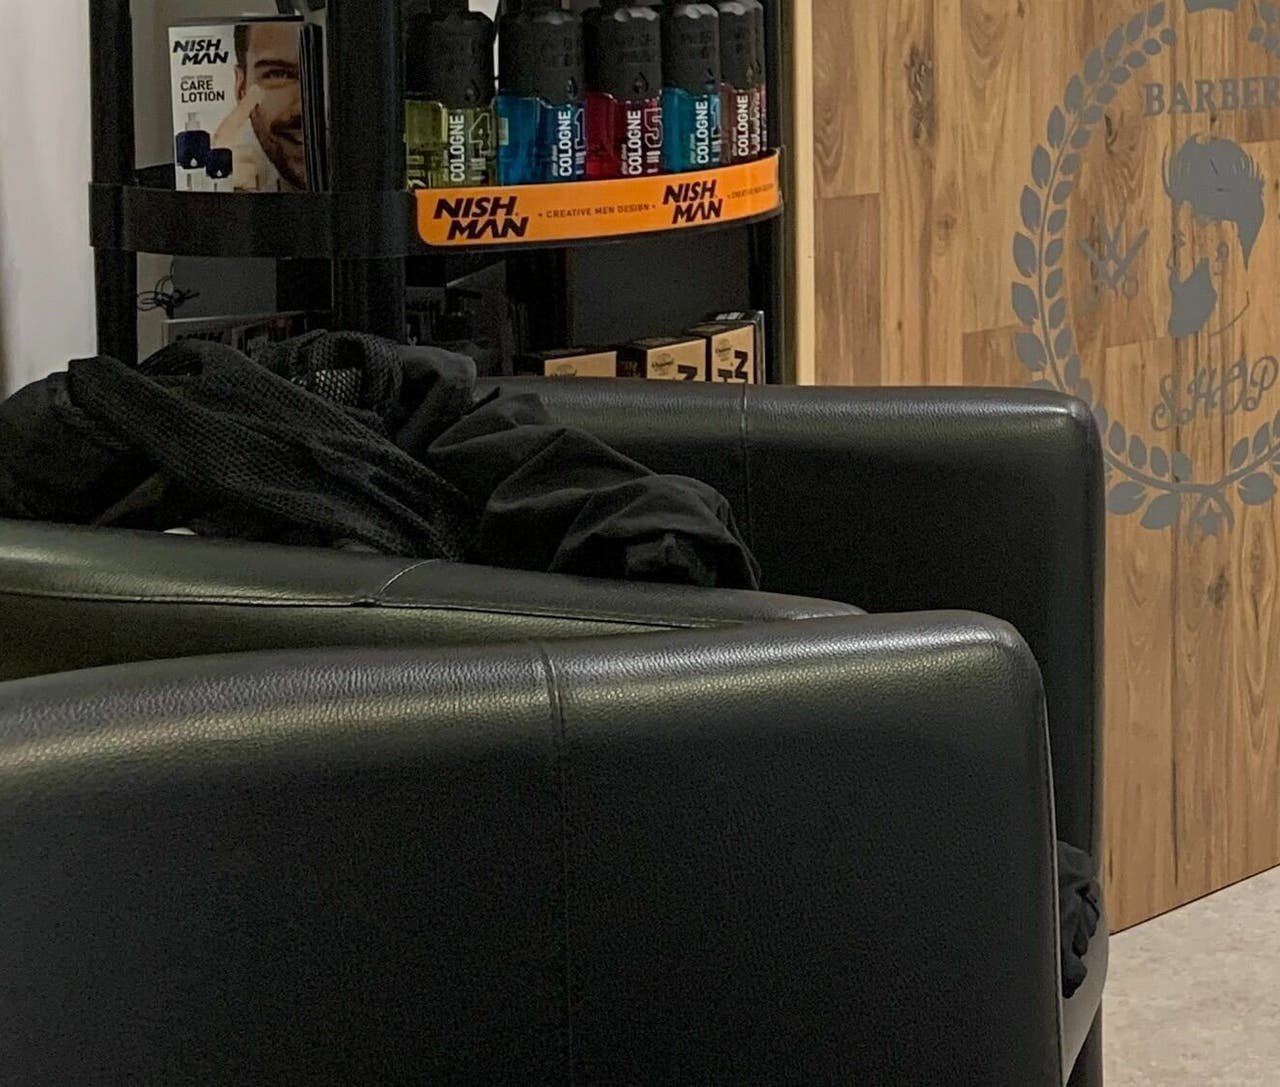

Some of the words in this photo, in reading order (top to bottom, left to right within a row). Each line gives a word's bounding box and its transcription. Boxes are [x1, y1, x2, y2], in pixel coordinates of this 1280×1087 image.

[173, 38, 221, 53] NISH
[181, 51, 229, 65] MAN
[180, 80, 213, 91] CARE
[181, 91, 225, 103] LOTION
[469, 113, 491, 157] 4
[695, 100, 709, 164] COLOGNE
[737, 94, 749, 157] COLOGNE
[450, 114, 465, 182] COLOGNE
[558, 110, 573, 177] COLOGNE
[627, 109, 643, 175] COLOGNE
[662, 179, 717, 205] NISH
[433, 196, 517, 219] NISH
[546, 209, 592, 219] CREATIVE
[594, 207, 615, 216] MEN
[617, 204, 650, 214] DESIGN
[672, 199, 723, 225] MAN
[447, 217, 529, 240] MAN
[1150, 355, 1280, 433] SHOP
